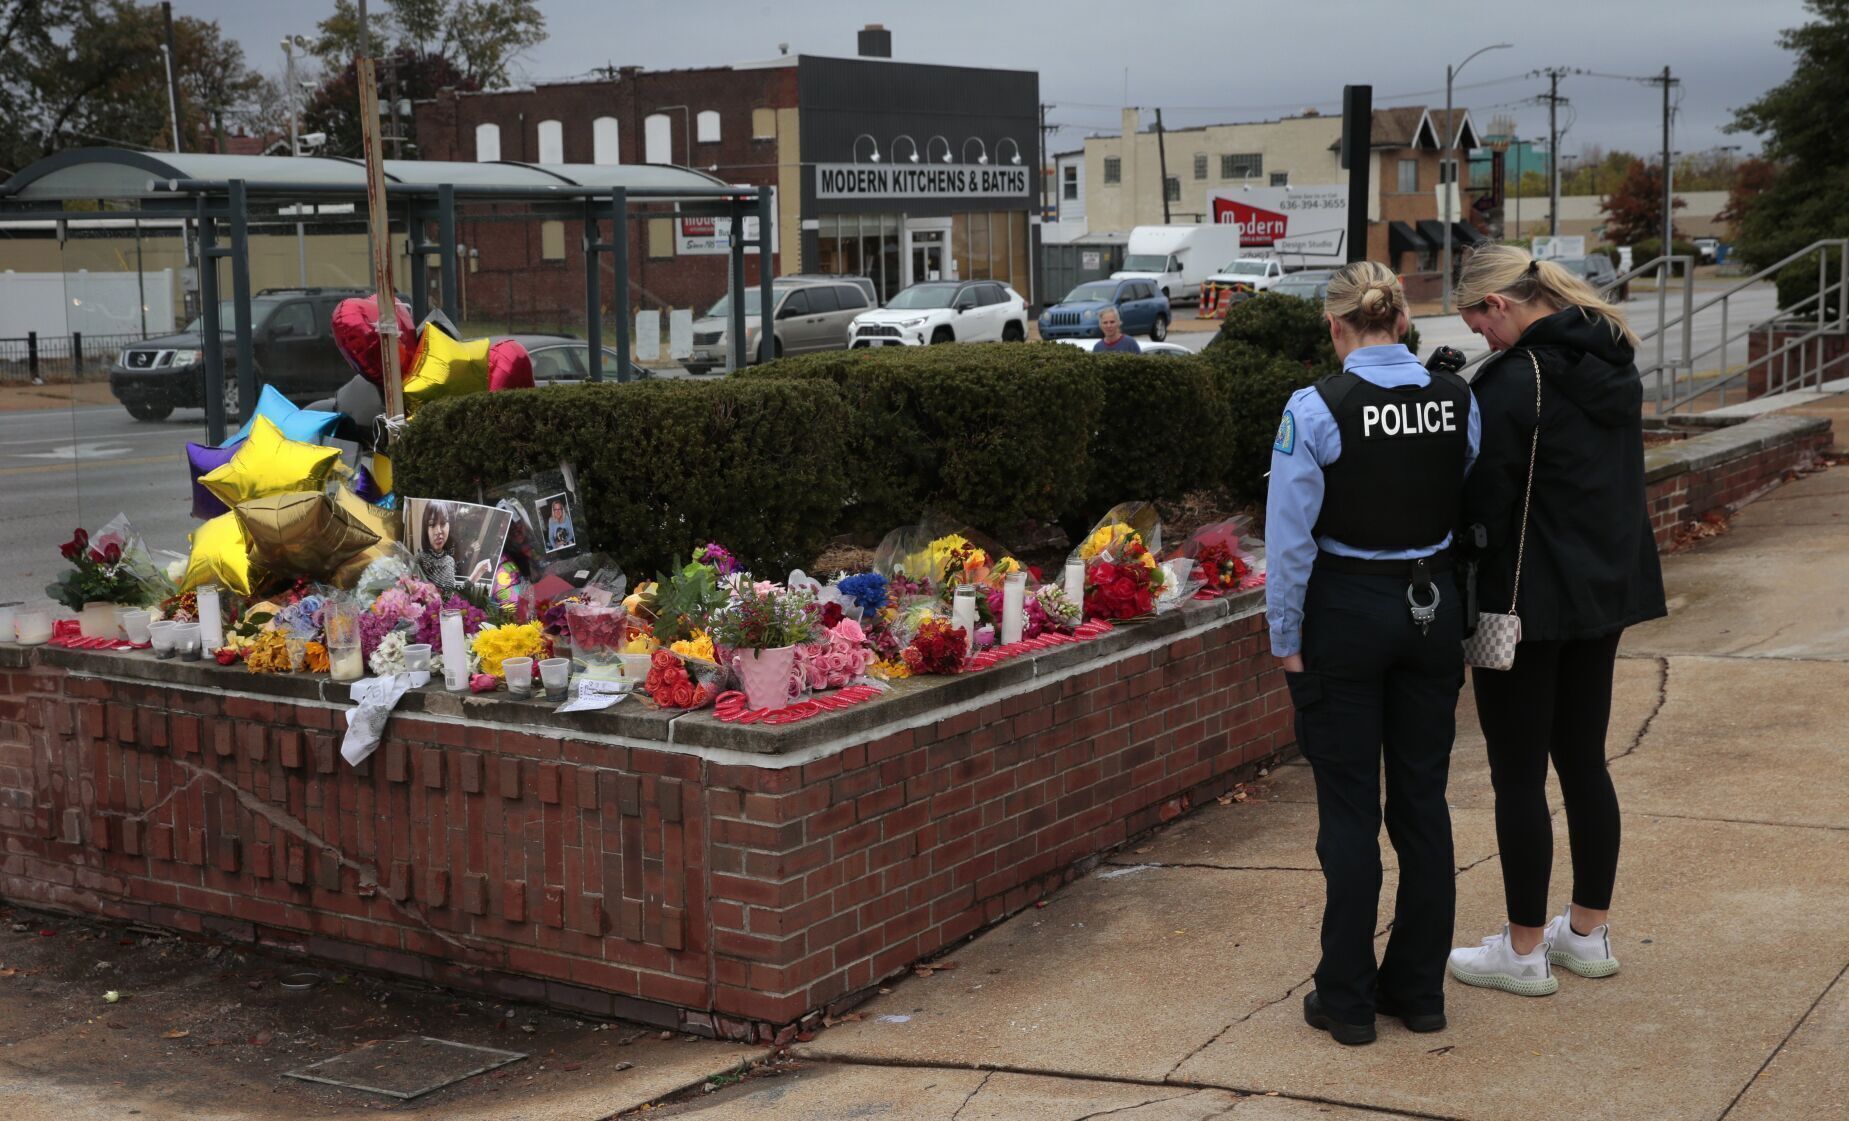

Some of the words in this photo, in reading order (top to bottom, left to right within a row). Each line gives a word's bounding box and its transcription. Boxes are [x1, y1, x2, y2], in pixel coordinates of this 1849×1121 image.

[822, 169, 888, 193] MODERN
[893, 170, 965, 192] KITCHENS
[969, 171, 978, 192] &
[982, 170, 1025, 192] BATHS
[1280, 199, 1346, 210] 636-394-3655
[1281, 241, 1306, 249] Design
[1308, 240, 1333, 248] Studio
[1363, 401, 1456, 437] POLICE
